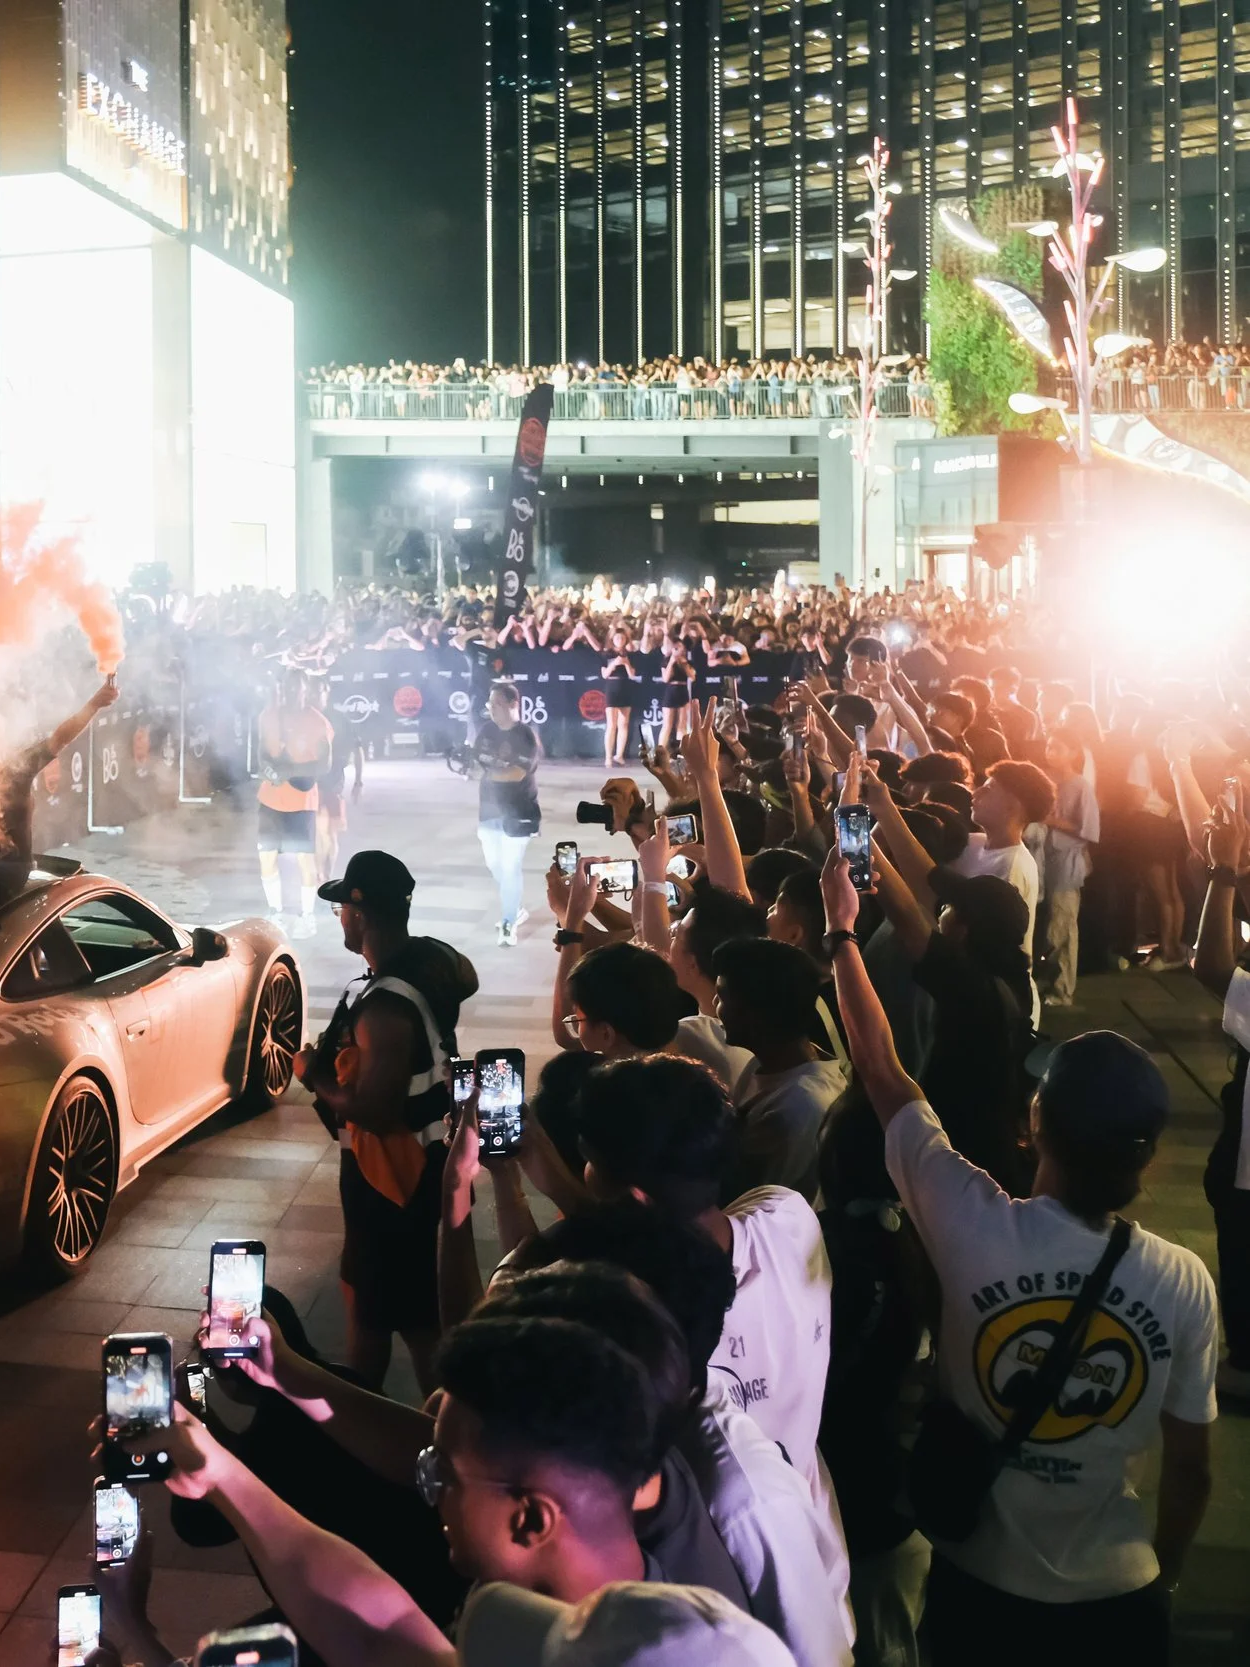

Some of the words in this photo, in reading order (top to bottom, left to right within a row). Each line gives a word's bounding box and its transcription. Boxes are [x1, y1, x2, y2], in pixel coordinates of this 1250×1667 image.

[971, 1280, 1011, 1313] ART
[1017, 1273, 1046, 1295] OF
[1125, 1300, 1172, 1362] STORE
[728, 1335, 746, 1358] 21
[1017, 1340, 1117, 1387] MON
